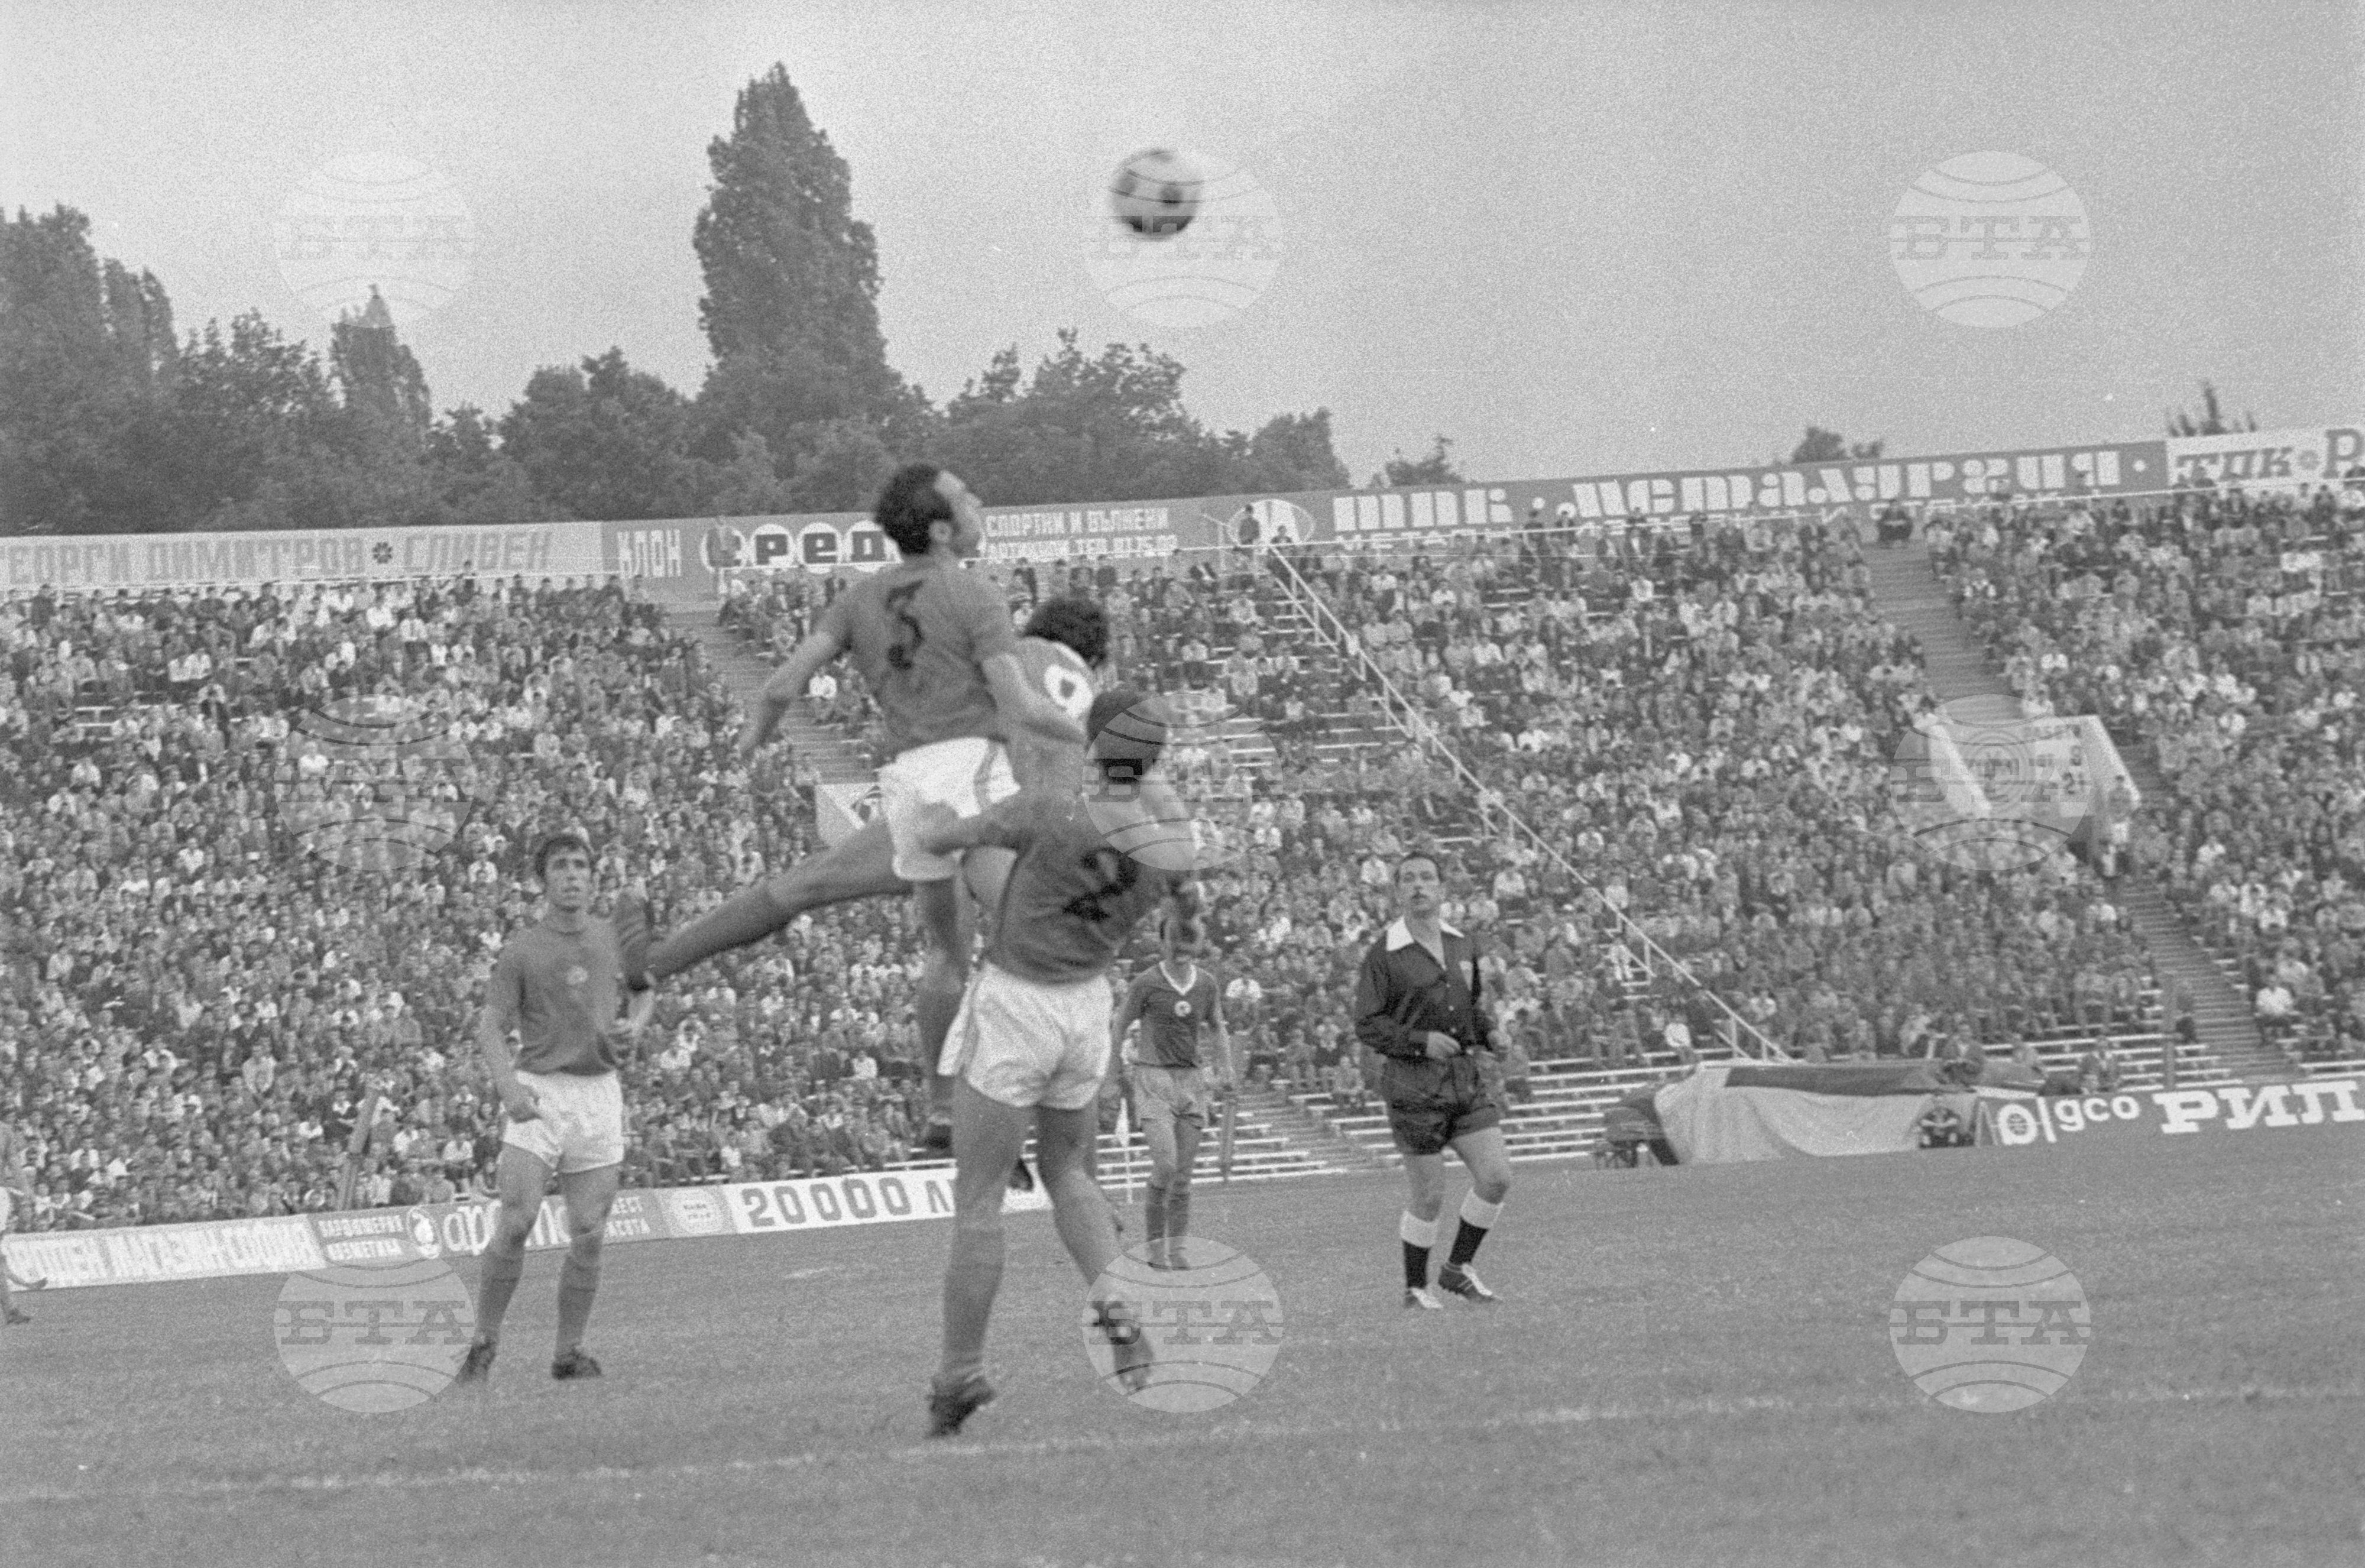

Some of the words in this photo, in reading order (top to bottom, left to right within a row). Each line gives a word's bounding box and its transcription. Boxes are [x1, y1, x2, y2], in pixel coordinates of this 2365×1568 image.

[0, 543, 131, 584] ЕОРГИ
[145, 538, 365, 582] ДИМИТРОВ
[403, 532, 553, 572] СЛИВЕН
[740, 1177, 913, 1227] 20000
